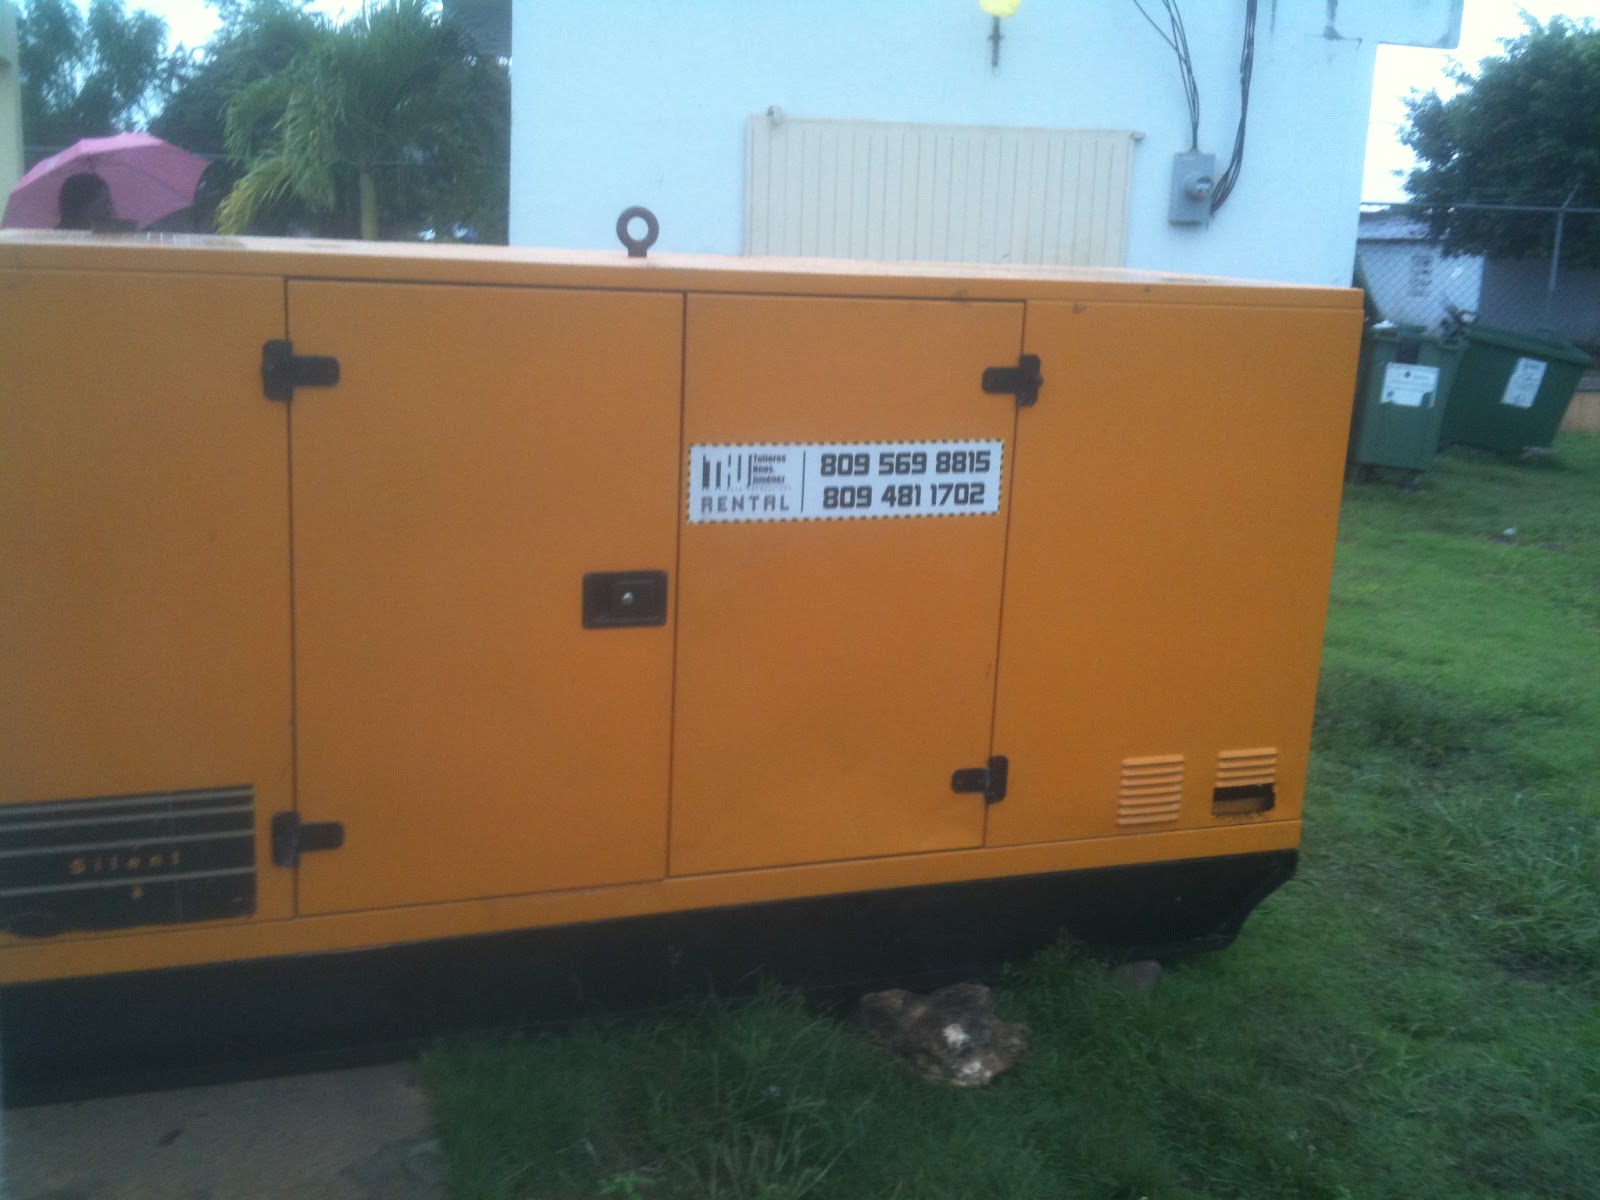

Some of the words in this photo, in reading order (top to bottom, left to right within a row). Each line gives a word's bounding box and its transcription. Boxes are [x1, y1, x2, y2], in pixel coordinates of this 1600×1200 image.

[820, 452, 871, 477] 809
[878, 451, 928, 476] 569
[935, 449, 991, 474] 8815
[701, 494, 790, 513] RENTAL
[822, 484, 873, 510] 809
[880, 483, 922, 508] 481
[930, 481, 986, 507] 1702
